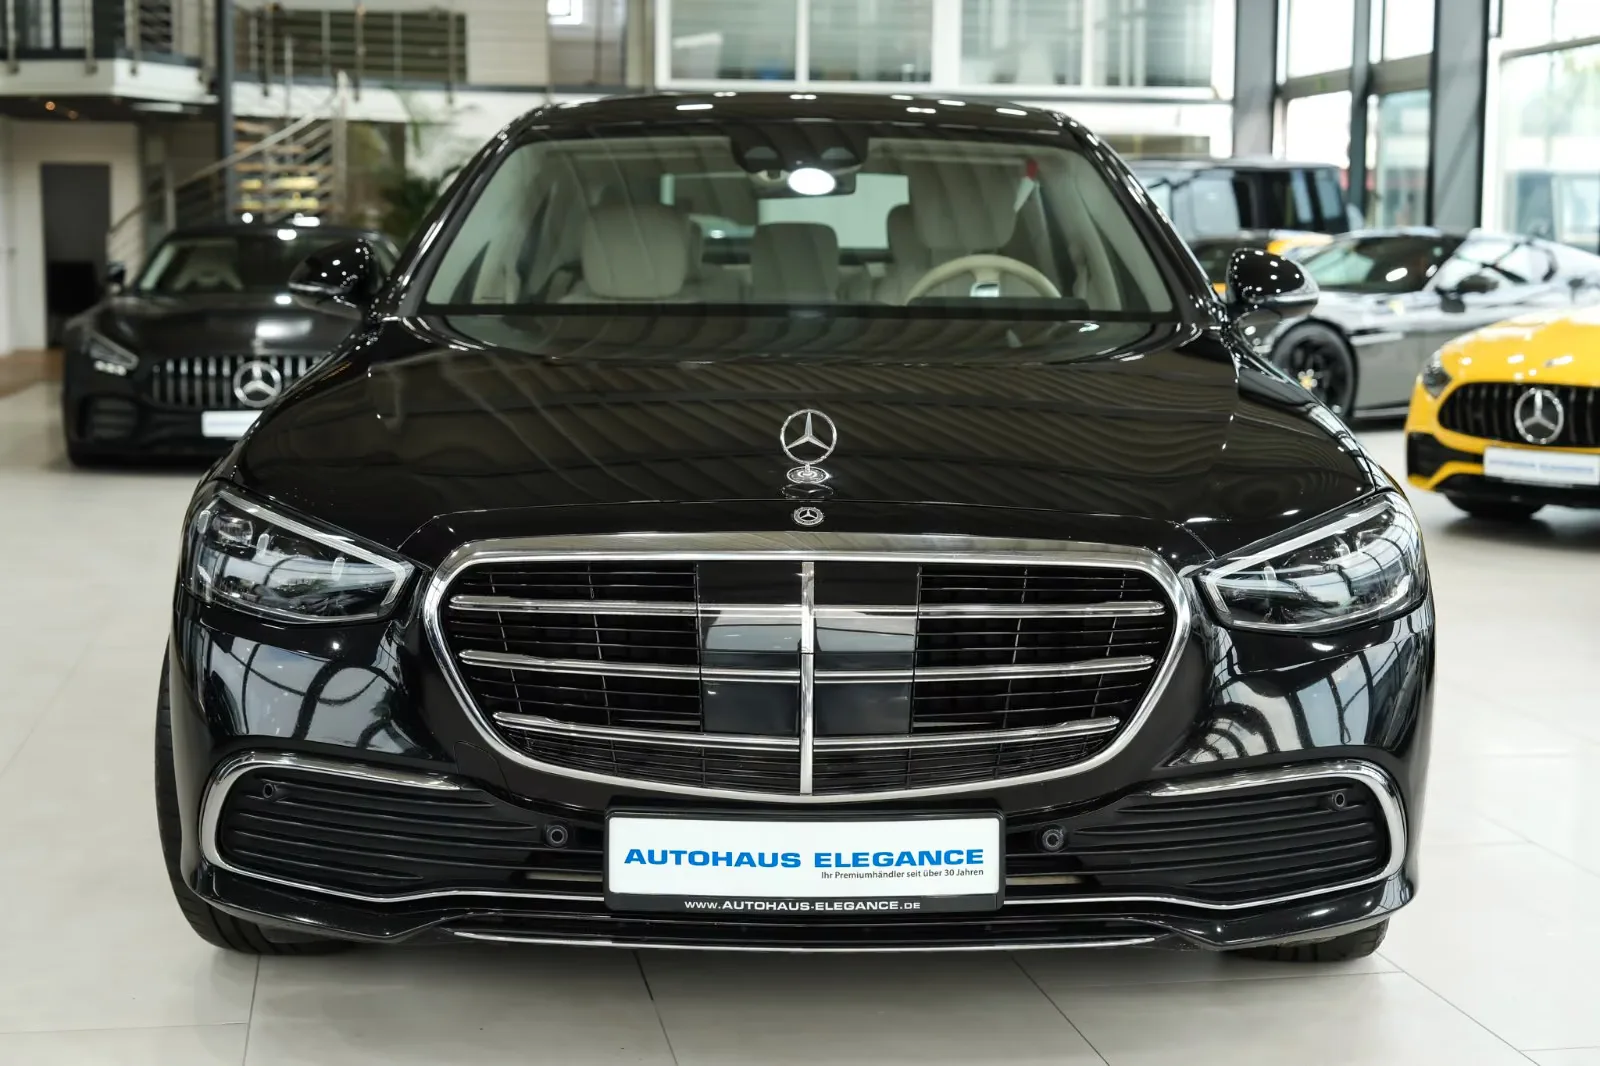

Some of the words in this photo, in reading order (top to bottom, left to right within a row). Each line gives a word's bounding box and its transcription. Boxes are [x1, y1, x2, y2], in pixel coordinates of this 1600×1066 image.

[624, 849, 801, 868] AUTOHAUS
[814, 849, 984, 868] ELEGANCE
[821, 870, 833, 880] Ihr
[834, 870, 905, 879] Premiumhändler
[906, 870, 922, 878] seit
[923, 869, 943, 878] über
[944, 869, 955, 877] 30
[956, 868, 984, 877] Jahren
